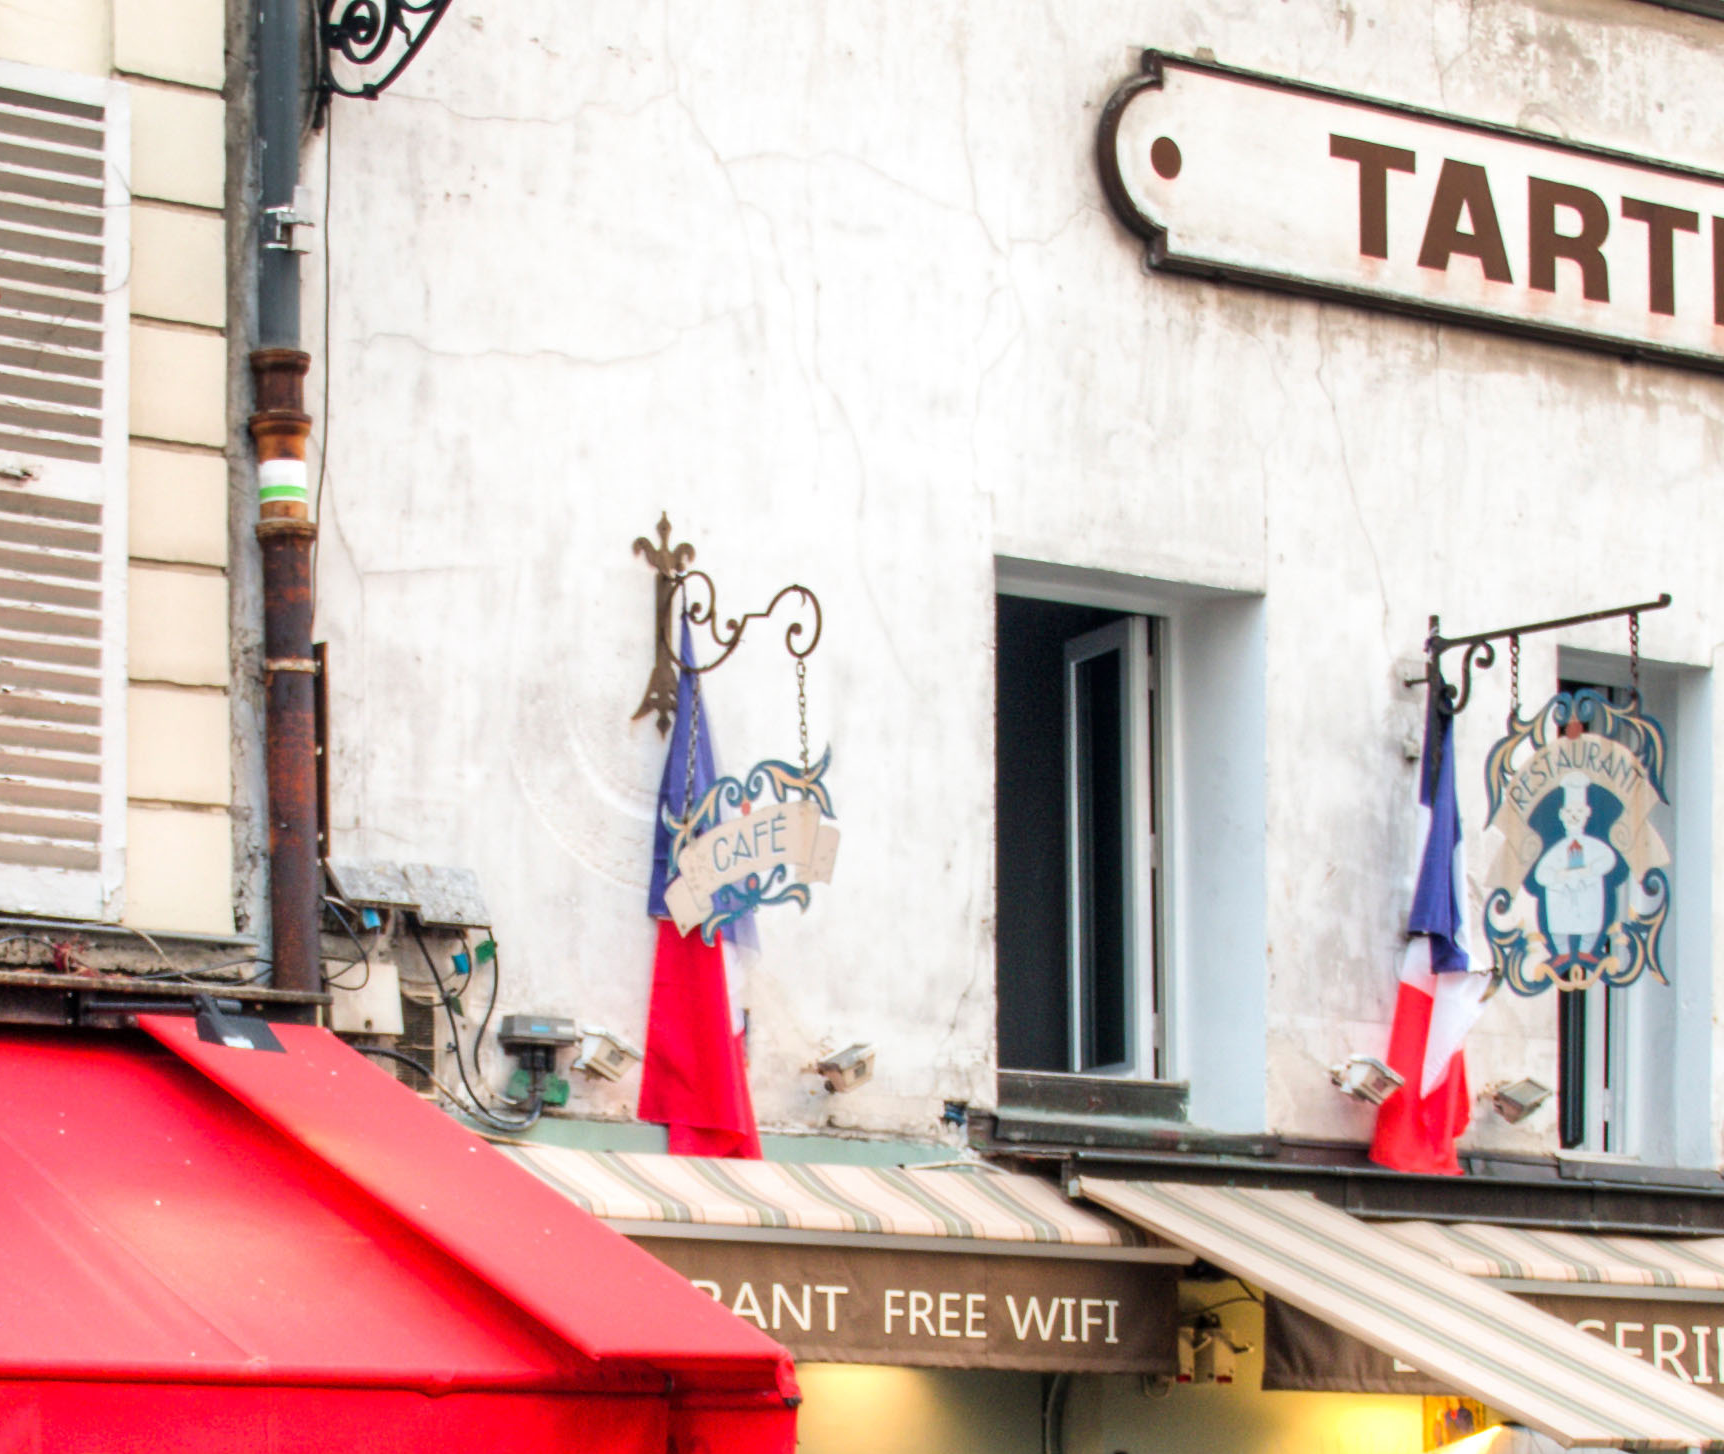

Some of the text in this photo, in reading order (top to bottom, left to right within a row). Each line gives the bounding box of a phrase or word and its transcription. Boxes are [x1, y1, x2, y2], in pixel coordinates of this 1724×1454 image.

[1510, 742, 1645, 811] RESTAURANT
[713, 812, 787, 873] CAFÉ
[884, 1290, 988, 1338] FREE
[1006, 1294, 1120, 1343] WIFI
